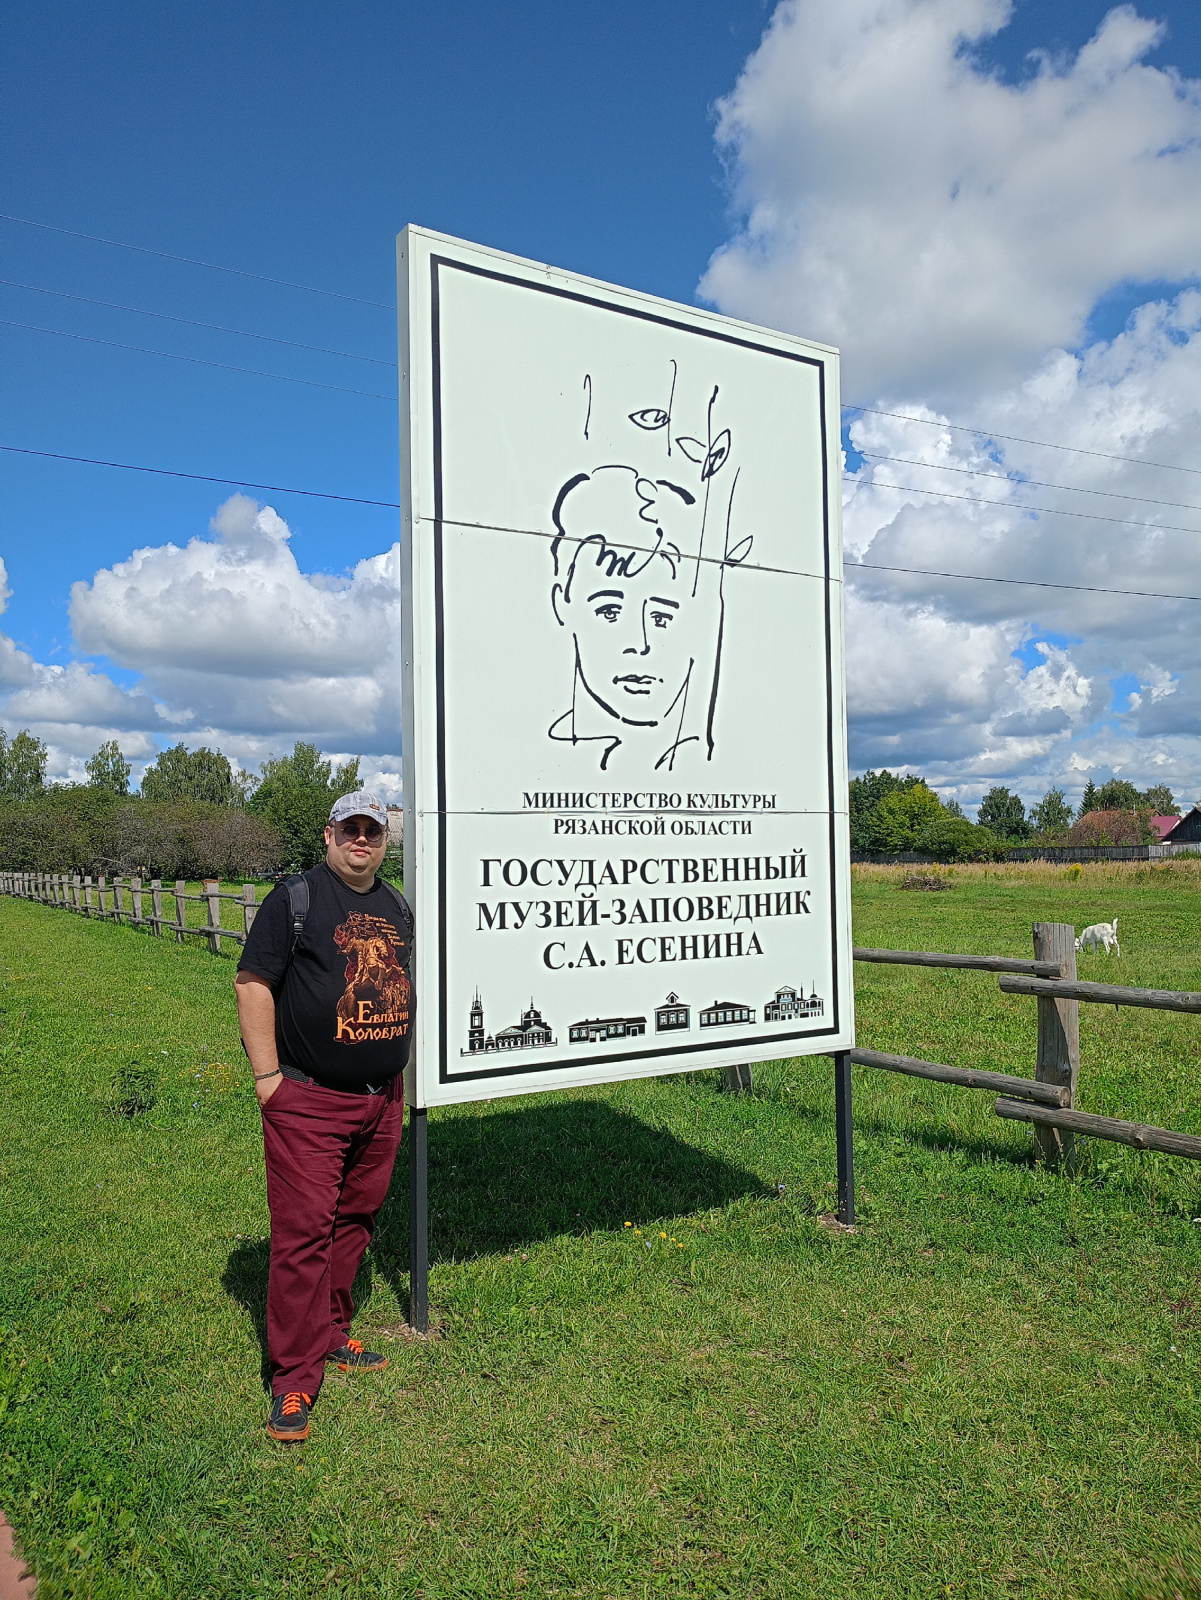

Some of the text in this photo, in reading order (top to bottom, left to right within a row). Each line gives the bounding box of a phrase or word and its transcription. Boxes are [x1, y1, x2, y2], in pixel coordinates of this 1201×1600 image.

[523, 792, 777, 809] МИНИСТЕРСТВО КУЛЬТУРЫ
[553, 816, 753, 836] РЯЗАНСКОЙ ОБЛАСТИ
[480, 848, 808, 892] ГОСУДАРСТВЕННЫЙ
[476, 890, 811, 931] МУЗЕЙ-ЗАПОВЕДНИК
[543, 931, 764, 970] С.А. ЕСЕНИНА
